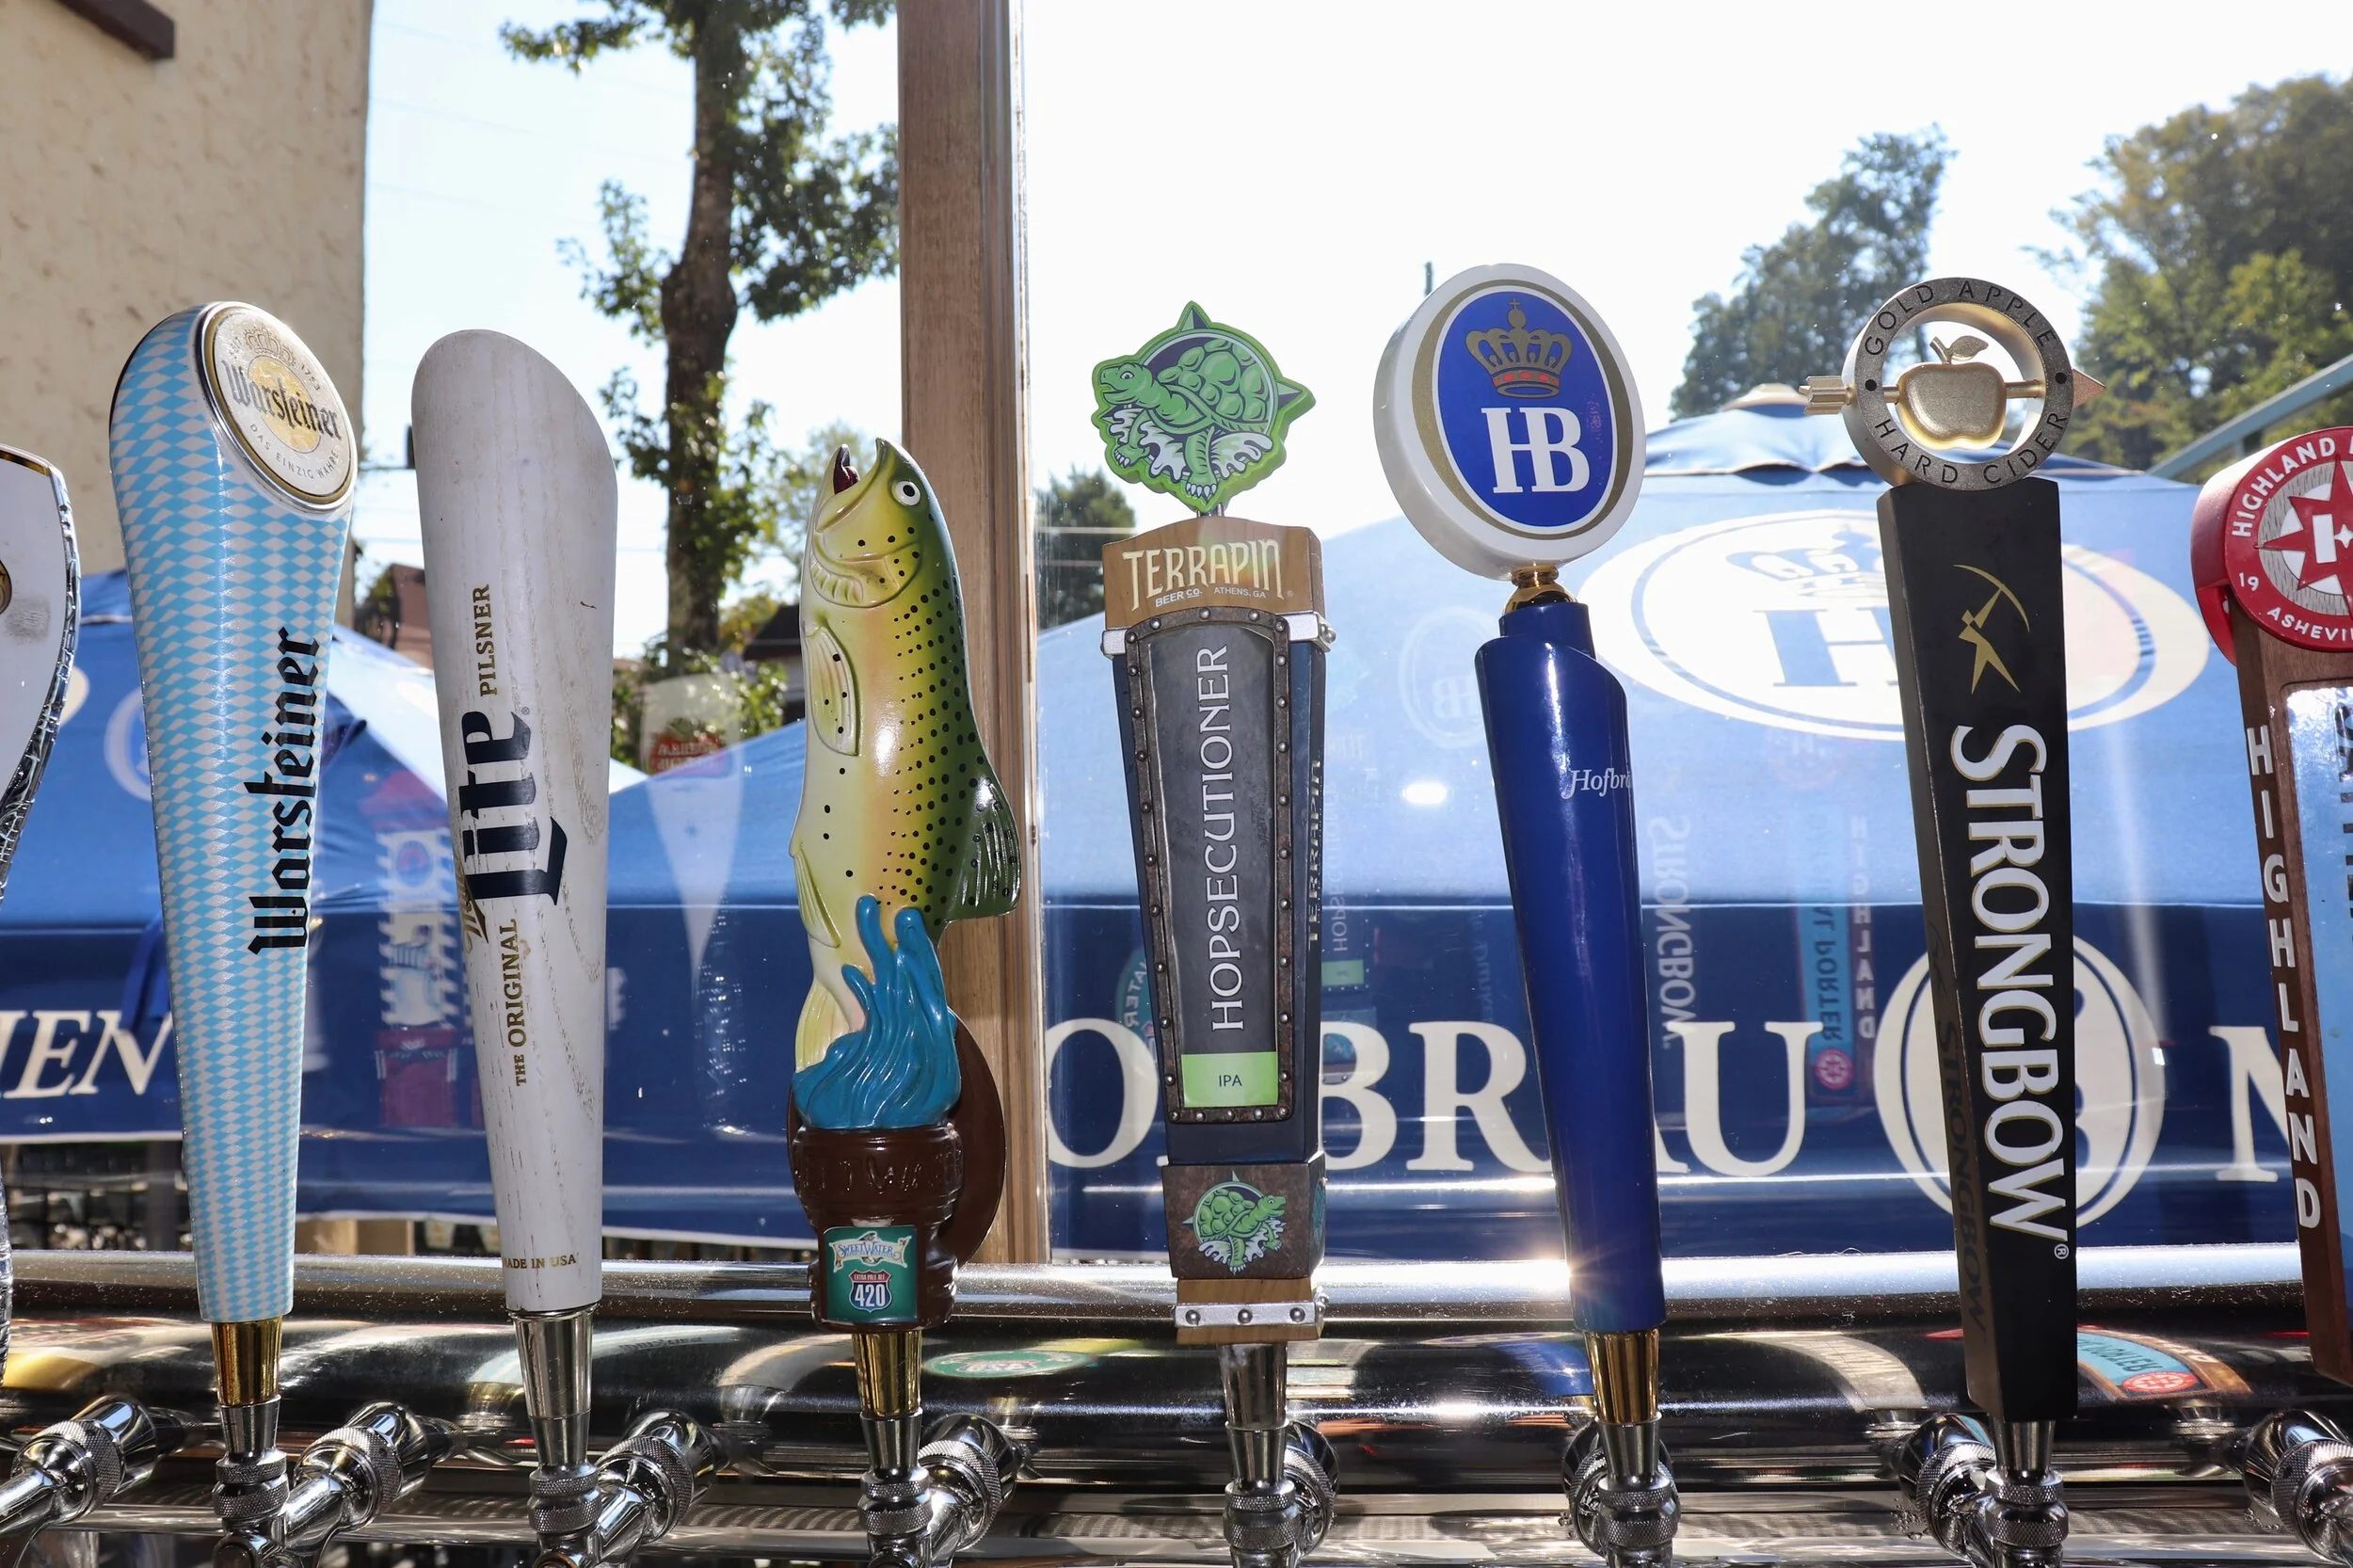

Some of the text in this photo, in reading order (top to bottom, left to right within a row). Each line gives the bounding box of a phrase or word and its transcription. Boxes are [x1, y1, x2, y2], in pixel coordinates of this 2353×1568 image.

[1865, 280, 2057, 356] GOLD APPLE
[221, 360, 342, 440] Warsteiner
[250, 424, 340, 479] DAS EINZIG WAHRE
[1481, 407, 1591, 494] HB
[1875, 412, 2068, 485] HARD CIDER
[2232, 437, 2336, 537] HIGHLAND
[1122, 538, 1284, 611] TERRAPIN
[1155, 591, 1184, 608] BEER
[1253, 590, 1266, 599] GA
[2239, 572, 2259, 591] 19
[472, 584, 497, 696] PILSNER
[244, 626, 320, 955] Warsteiner
[458, 711, 568, 907] Lite
[1197, 645, 1245, 1033] HOPSECUTIONER
[500, 919, 527, 1086] THE ORIGINAL
[1950, 724, 2069, 1241] STRONGBOW
[2247, 725, 2321, 1229] HIGHLAND
[1219, 1075, 1242, 1087] IPA
[532, 1257, 545, 1269] IN
[551, 1254, 576, 1267] USA
[855, 1284, 886, 1307] 420
